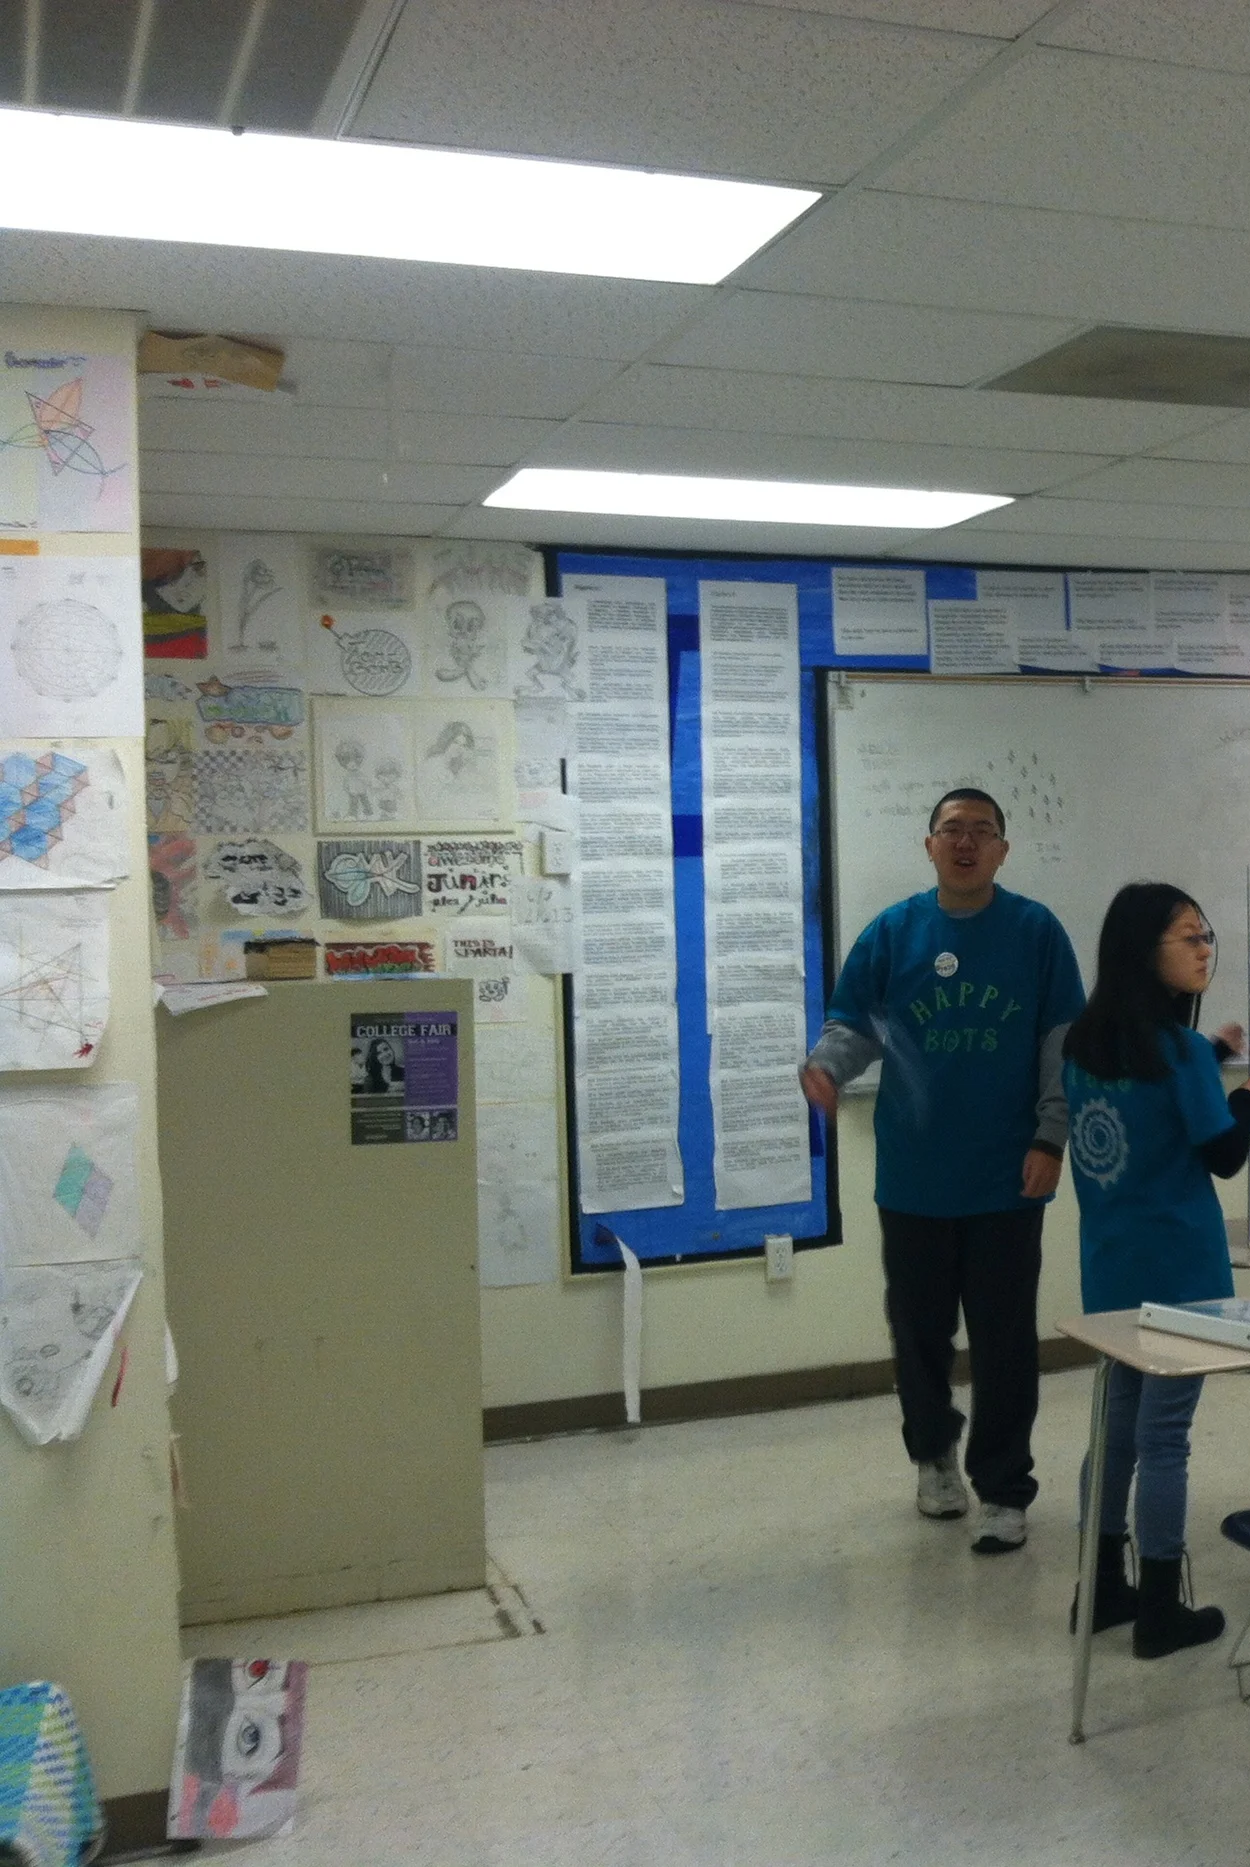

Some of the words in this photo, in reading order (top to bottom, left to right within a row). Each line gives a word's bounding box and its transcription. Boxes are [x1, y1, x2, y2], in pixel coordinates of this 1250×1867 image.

[910, 982, 1022, 1025] HAPPY
[356, 1024, 415, 1038] COLLEGE
[420, 1023, 451, 1036] FAIR
[926, 1029, 999, 1052] BOTS
